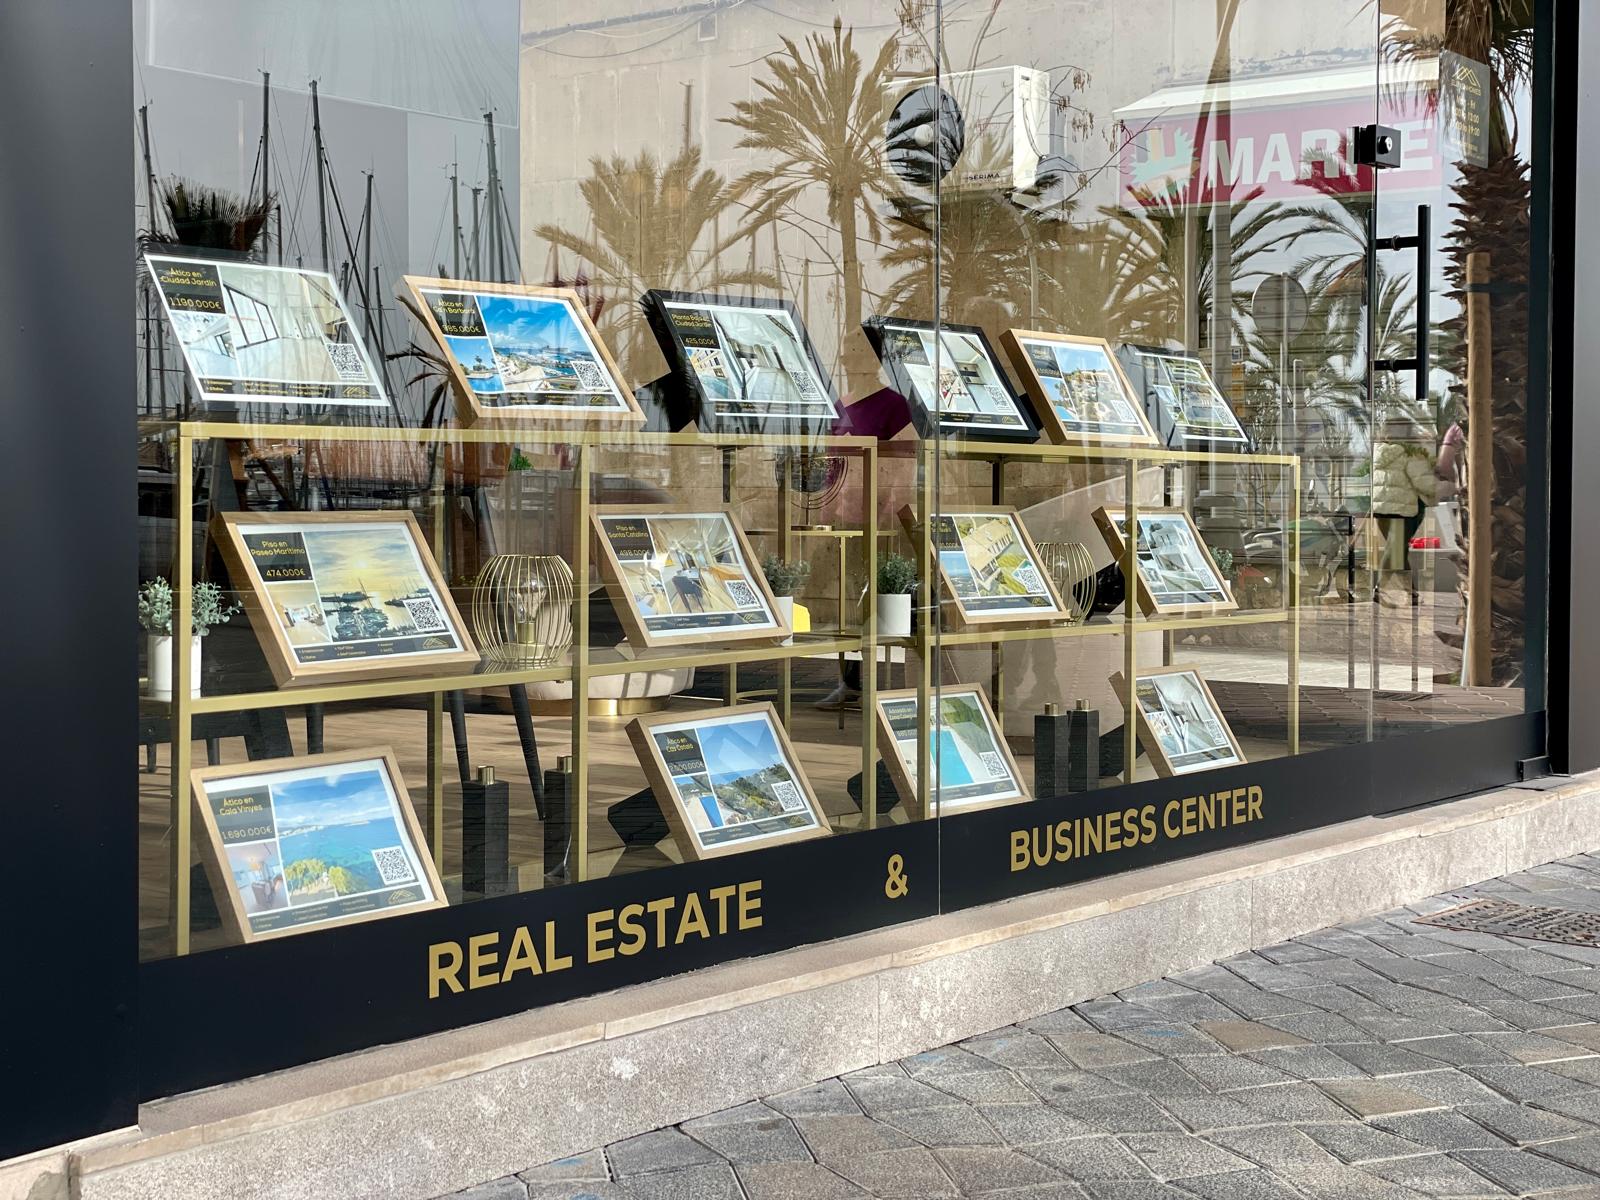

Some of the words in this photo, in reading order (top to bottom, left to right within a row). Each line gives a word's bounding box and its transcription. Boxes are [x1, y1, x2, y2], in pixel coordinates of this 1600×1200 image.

[1207, 119, 1434, 188] MARE
[161, 276, 190, 285] Ciudad
[266, 568, 306, 577] 474.000€
[219, 807, 238, 816] Cala
[237, 804, 263, 814] Vinyes
[428, 920, 573, 999] REAL
[586, 879, 763, 964] ESTATE
[885, 853, 909, 899] &
[1010, 804, 1157, 872] BUSINESS
[1163, 785, 1264, 839] CENTER
